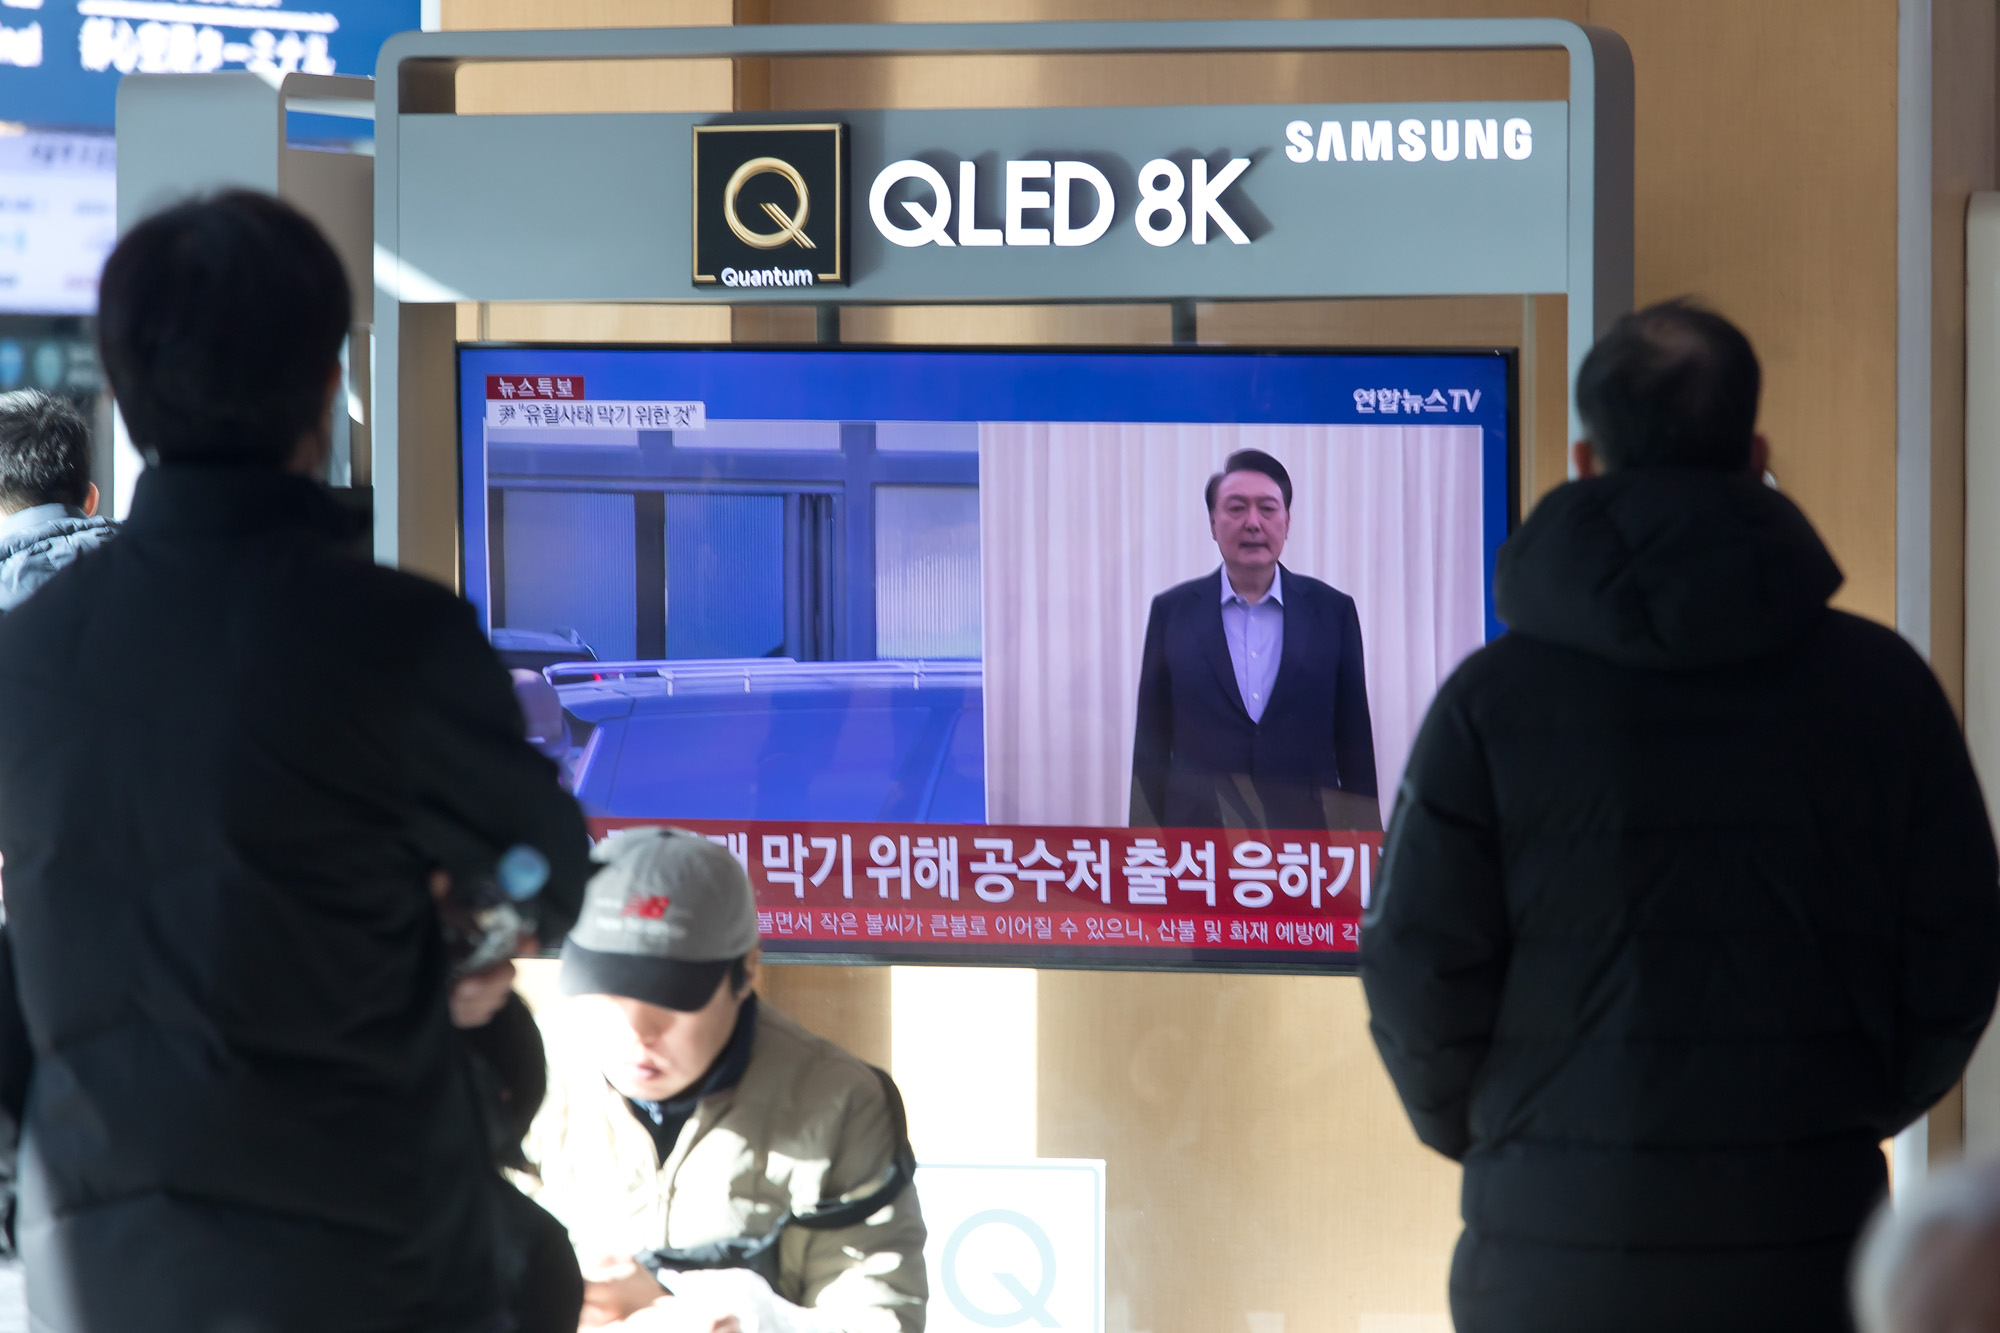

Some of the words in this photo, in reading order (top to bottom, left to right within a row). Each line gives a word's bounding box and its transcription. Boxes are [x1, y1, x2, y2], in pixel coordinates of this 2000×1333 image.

[1285, 117, 1533, 164] SAMSUNG
[723, 156, 818, 250] Q
[868, 158, 1116, 248] QLED
[1134, 157, 1252, 248] 8K
[720, 265, 814, 288] Quantum
[498, 377, 574, 399] 뉴스특보
[1352, 387, 1483, 415] 연합뉴스TV
[597, 404, 632, 428] 막기
[761, 832, 854, 899] 막기
[865, 833, 960, 901] 위해
[969, 836, 1112, 904] 공수처
[1122, 838, 1217, 907] 출석
[1227, 840, 1384, 910] 응하기
[756, 910, 814, 936] 불면서
[819, 911, 858, 936] 작은
[864, 912, 924, 938] 불씨가
[928, 913, 989, 938] 큰불로
[995, 914, 1053, 940] 이어질
[1059, 916, 1079, 941] 수
[1085, 916, 1150, 943] 있으니,
[1157, 918, 1197, 943] 산불
[1203, 919, 1222, 944] 및
[1228, 919, 1269, 945] 화재
[1275, 920, 1334, 946] 예방에
